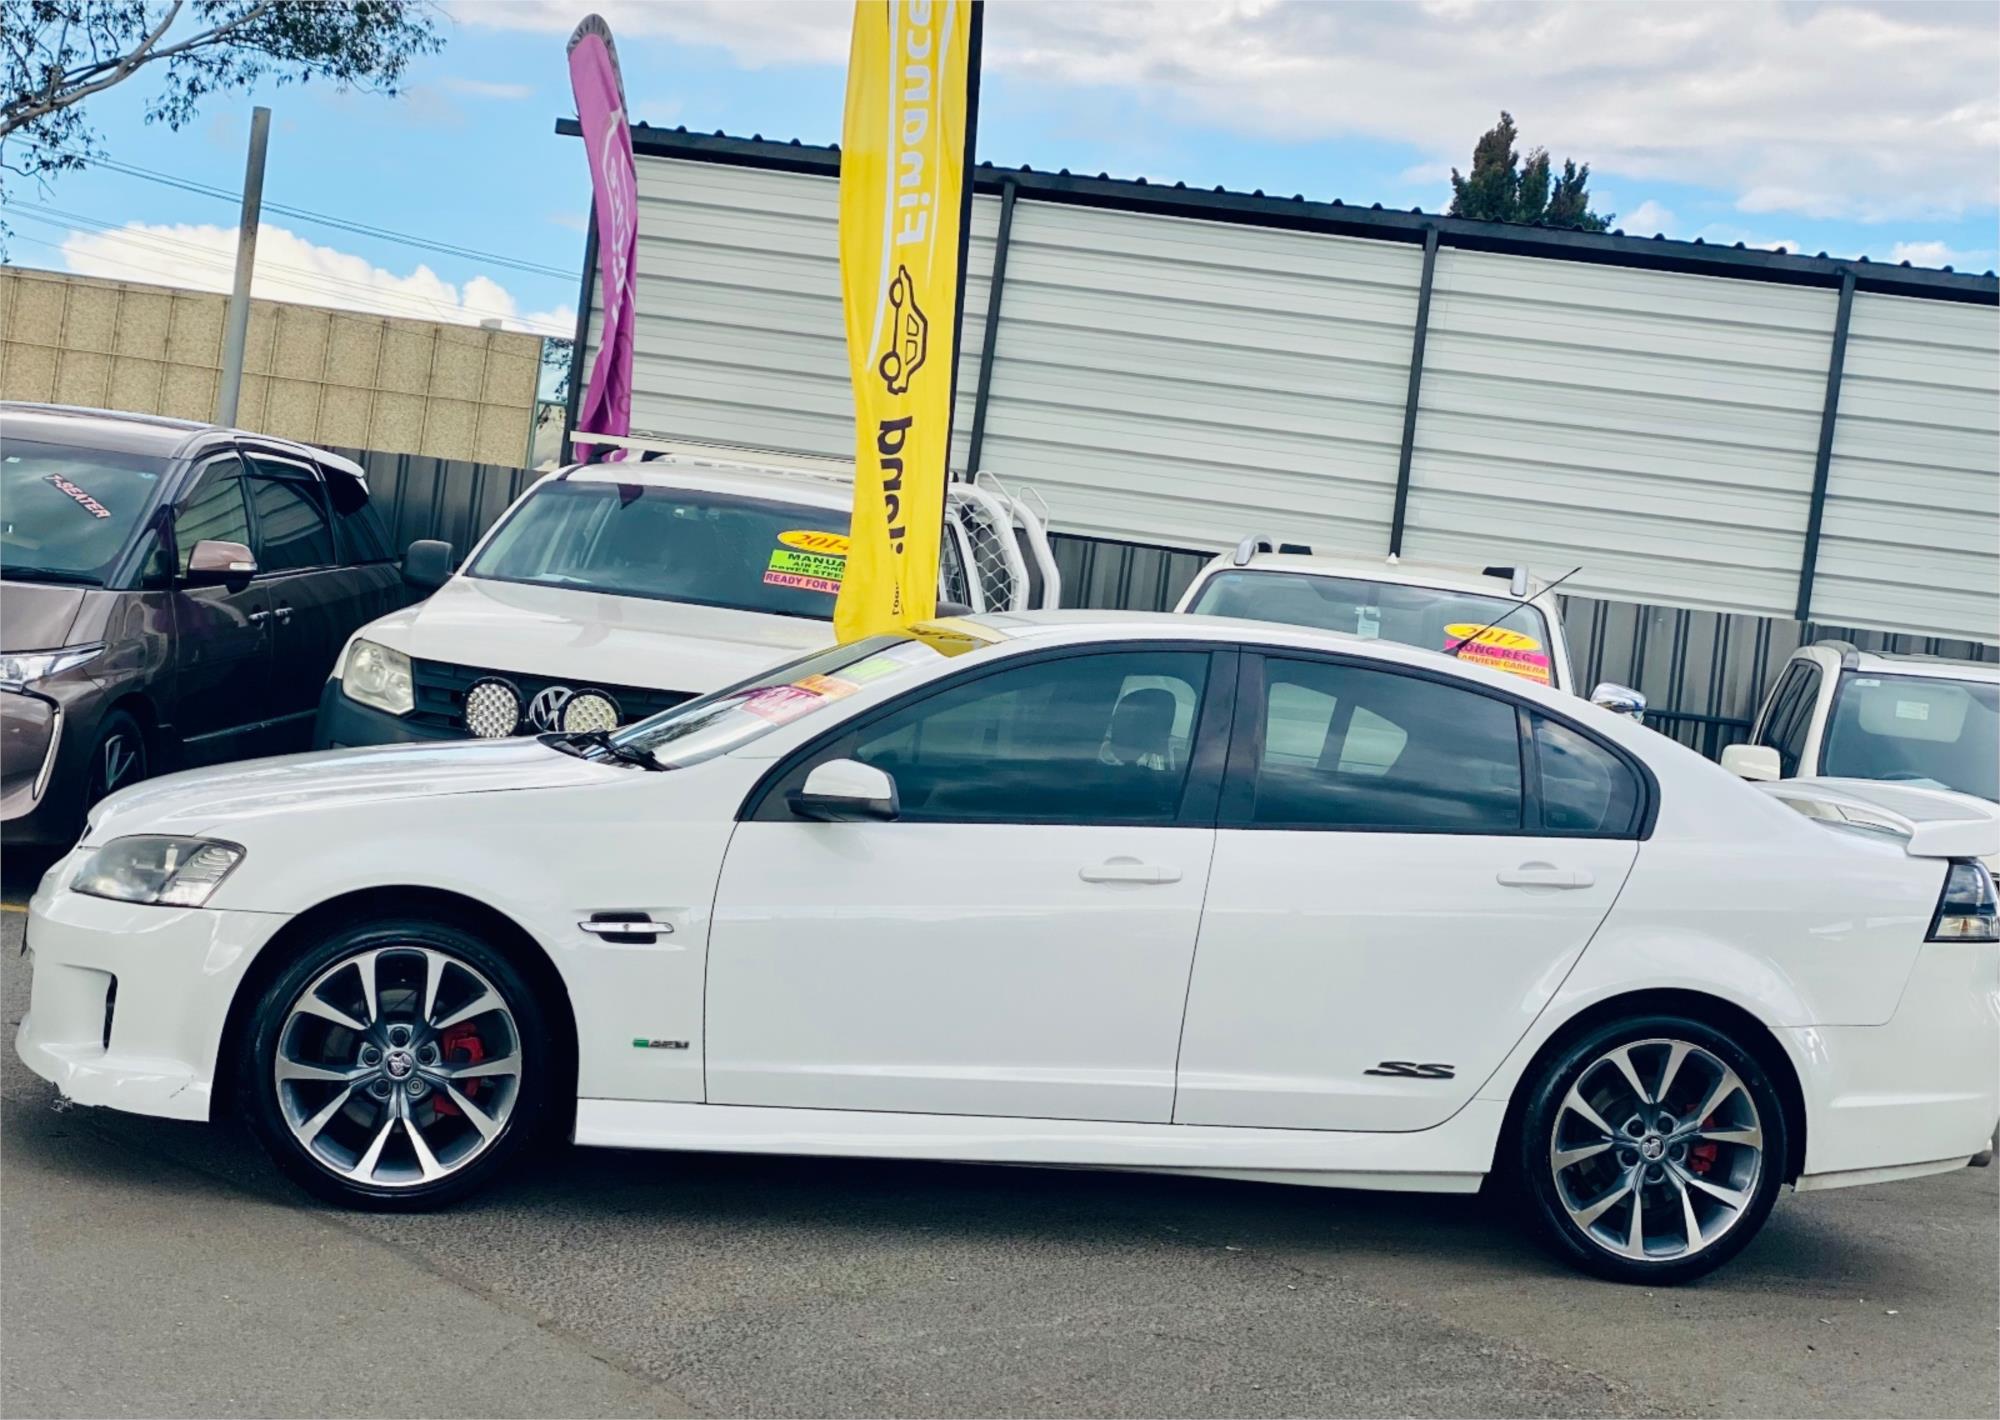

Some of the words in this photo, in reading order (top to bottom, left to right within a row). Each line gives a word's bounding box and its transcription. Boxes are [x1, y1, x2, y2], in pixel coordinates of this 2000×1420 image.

[44, 474, 111, 518] 7-SEATER
[788, 553, 846, 567] MANUA
[765, 573, 803, 585] READY
[805, 579, 828, 590] FOR
[1500, 650, 1532, 662] REG
[1503, 660, 1547, 674] CAMERA
[1363, 1060, 1456, 1080] SS
